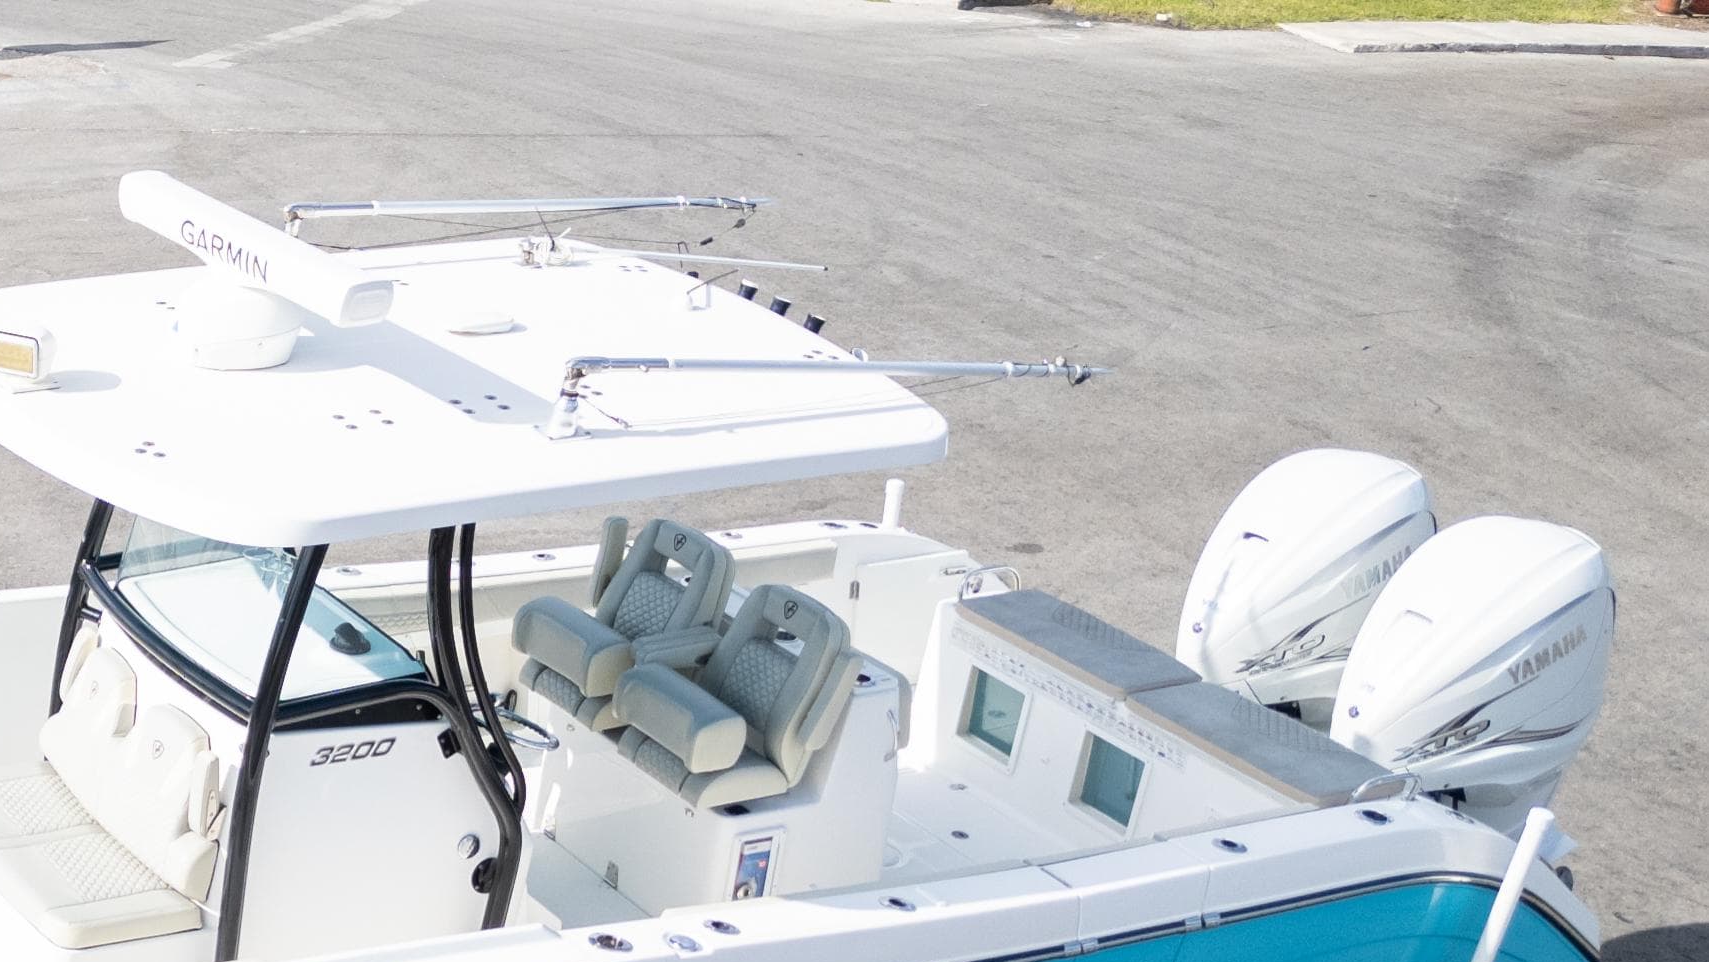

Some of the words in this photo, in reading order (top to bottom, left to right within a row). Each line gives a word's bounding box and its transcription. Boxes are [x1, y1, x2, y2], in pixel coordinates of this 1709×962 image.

[180, 219, 268, 284] GARMIN
[1506, 624, 1587, 684] YAMAHA
[309, 737, 397, 767] 3200
